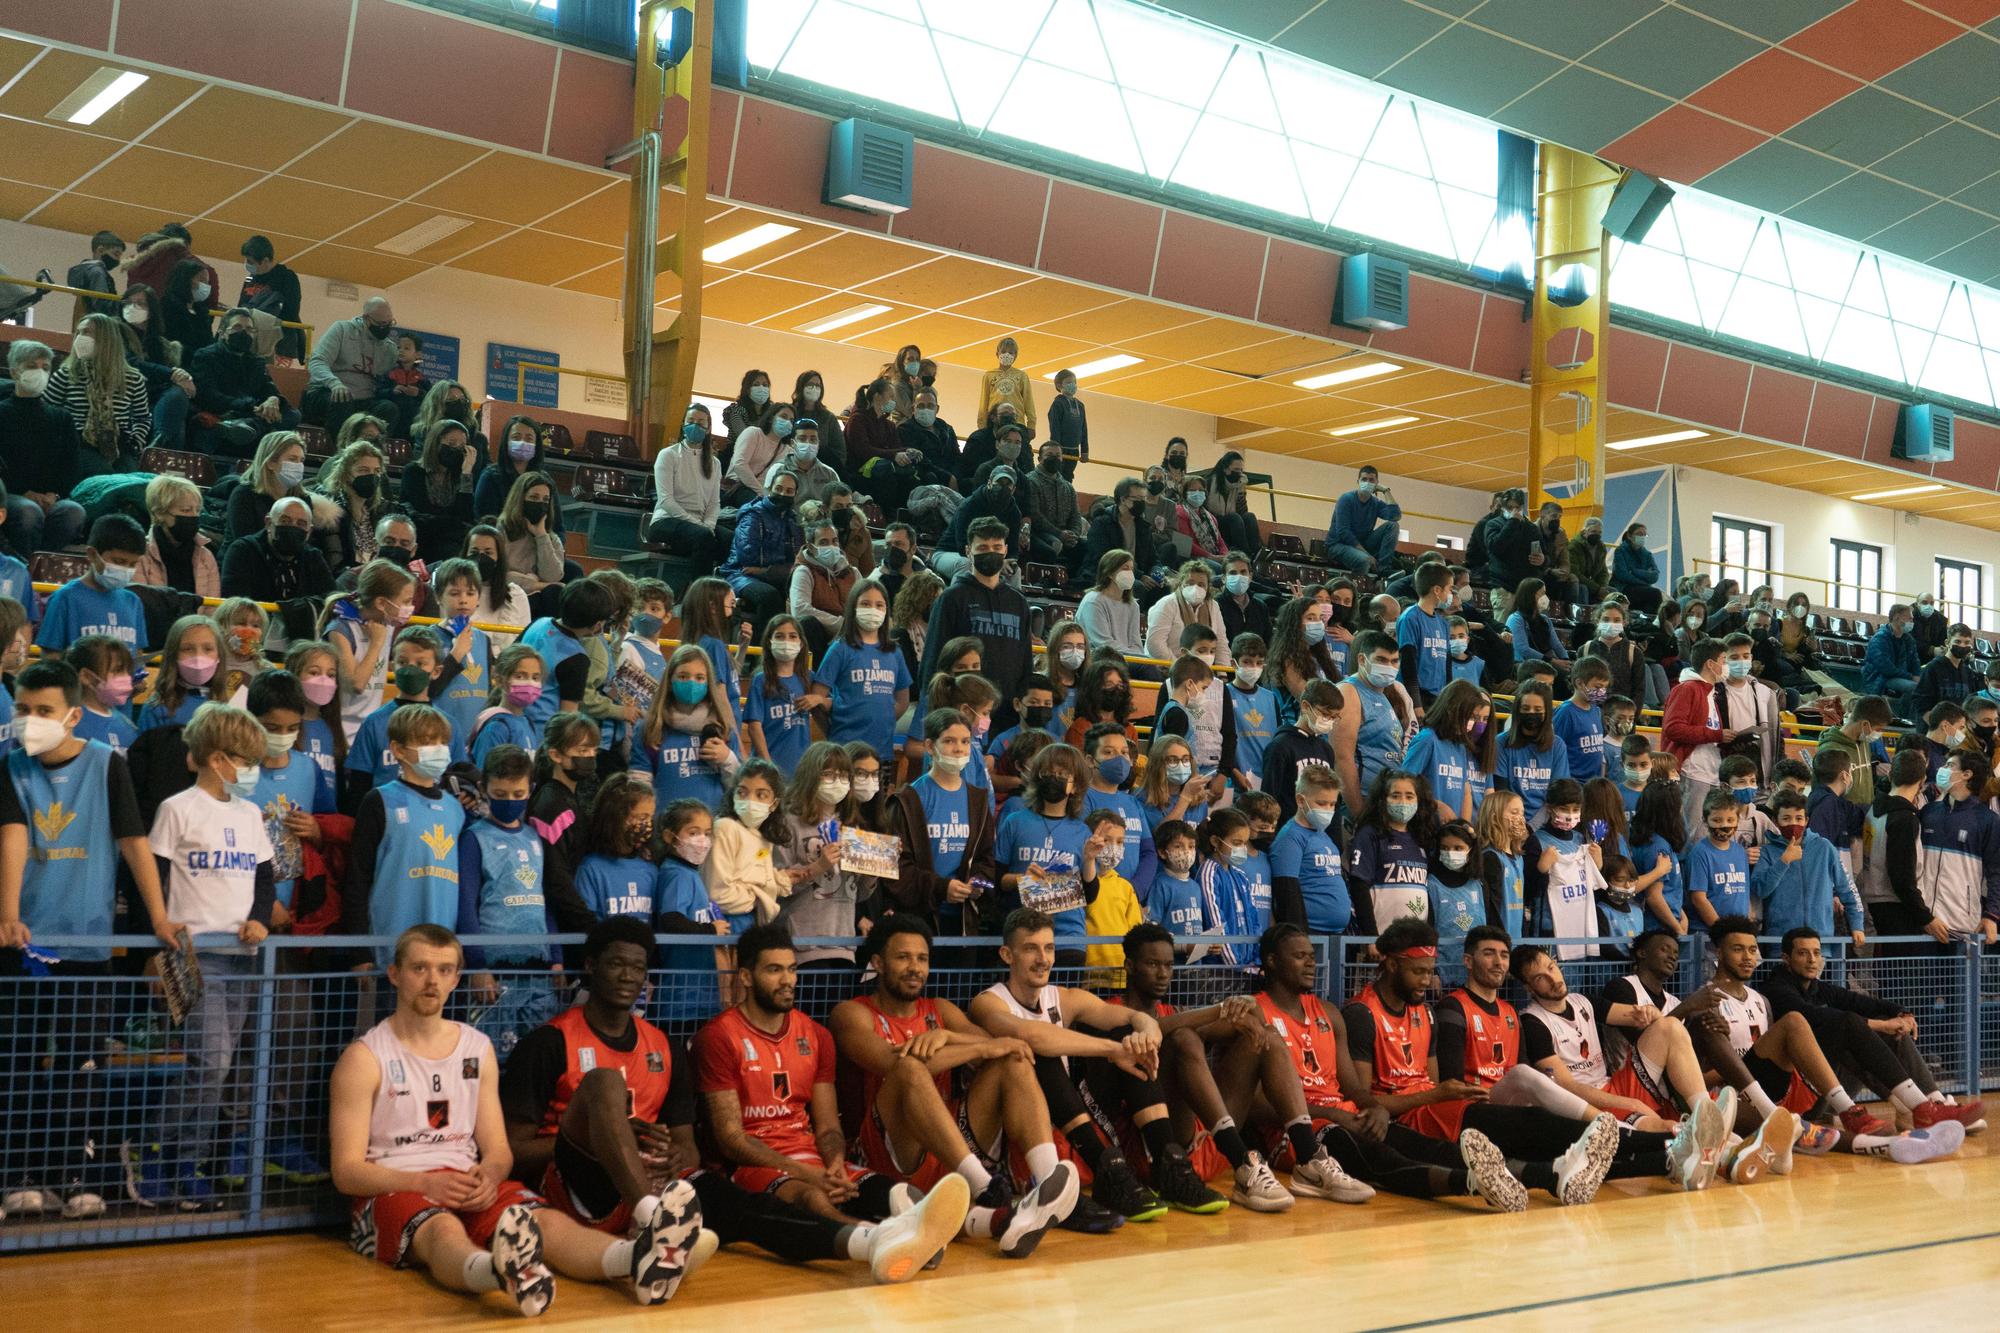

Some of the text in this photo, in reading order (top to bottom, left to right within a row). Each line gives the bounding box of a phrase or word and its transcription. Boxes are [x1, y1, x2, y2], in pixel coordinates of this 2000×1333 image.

[100, 624, 136, 644] ZAMOR
[971, 622, 1021, 640] ZAMORA
[851, 669, 895, 684] CB ZAMOR
[770, 704, 783, 720] CB
[1580, 735, 1591, 748] CB
[663, 748, 678, 764] CB
[1523, 767, 1551, 780] ZAMOR
[927, 824, 970, 838] CB ZAMO
[188, 850, 256, 871] CB ZAMOR
[1018, 847, 1030, 861] CB
[1352, 849, 1361, 865] 3
[1383, 863, 1428, 886] ZAMOR
[1714, 873, 1725, 884] CB
[1562, 886, 1574, 899] CB
[1171, 907, 1203, 924] CB ZAM
[432, 1074, 441, 1092] 8
[1301, 1075, 1327, 1087] OVA
[745, 1105, 791, 1118] INNOVA
